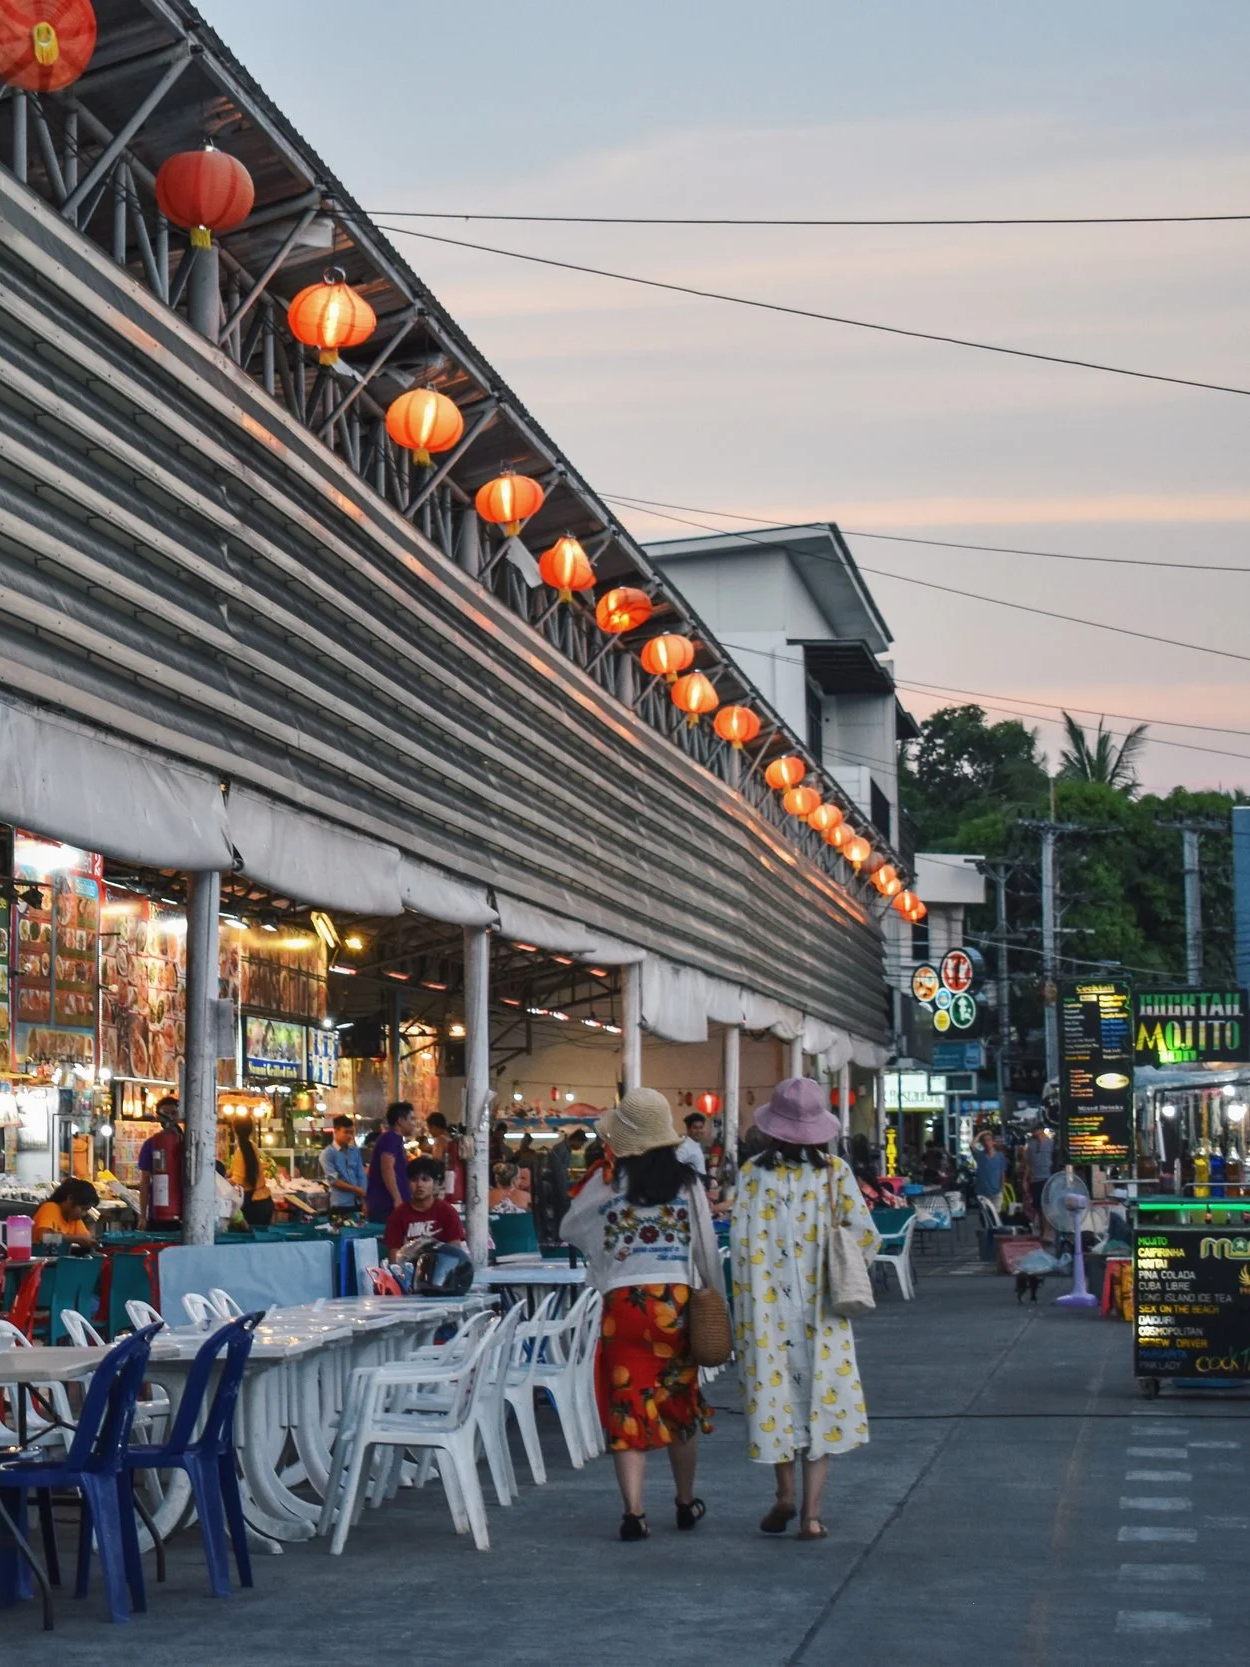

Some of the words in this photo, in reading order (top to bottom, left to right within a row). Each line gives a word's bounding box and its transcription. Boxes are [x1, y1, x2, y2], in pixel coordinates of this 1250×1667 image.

[1136, 1020, 1240, 1051] MOJITO
[407, 1220, 437, 1238] NIKE
[1138, 1236, 1168, 1246] MOJITO
[1160, 1271, 1196, 1280] COLADA
[1138, 1281, 1161, 1291] CUBA
[1165, 1281, 1190, 1291] LIBRE
